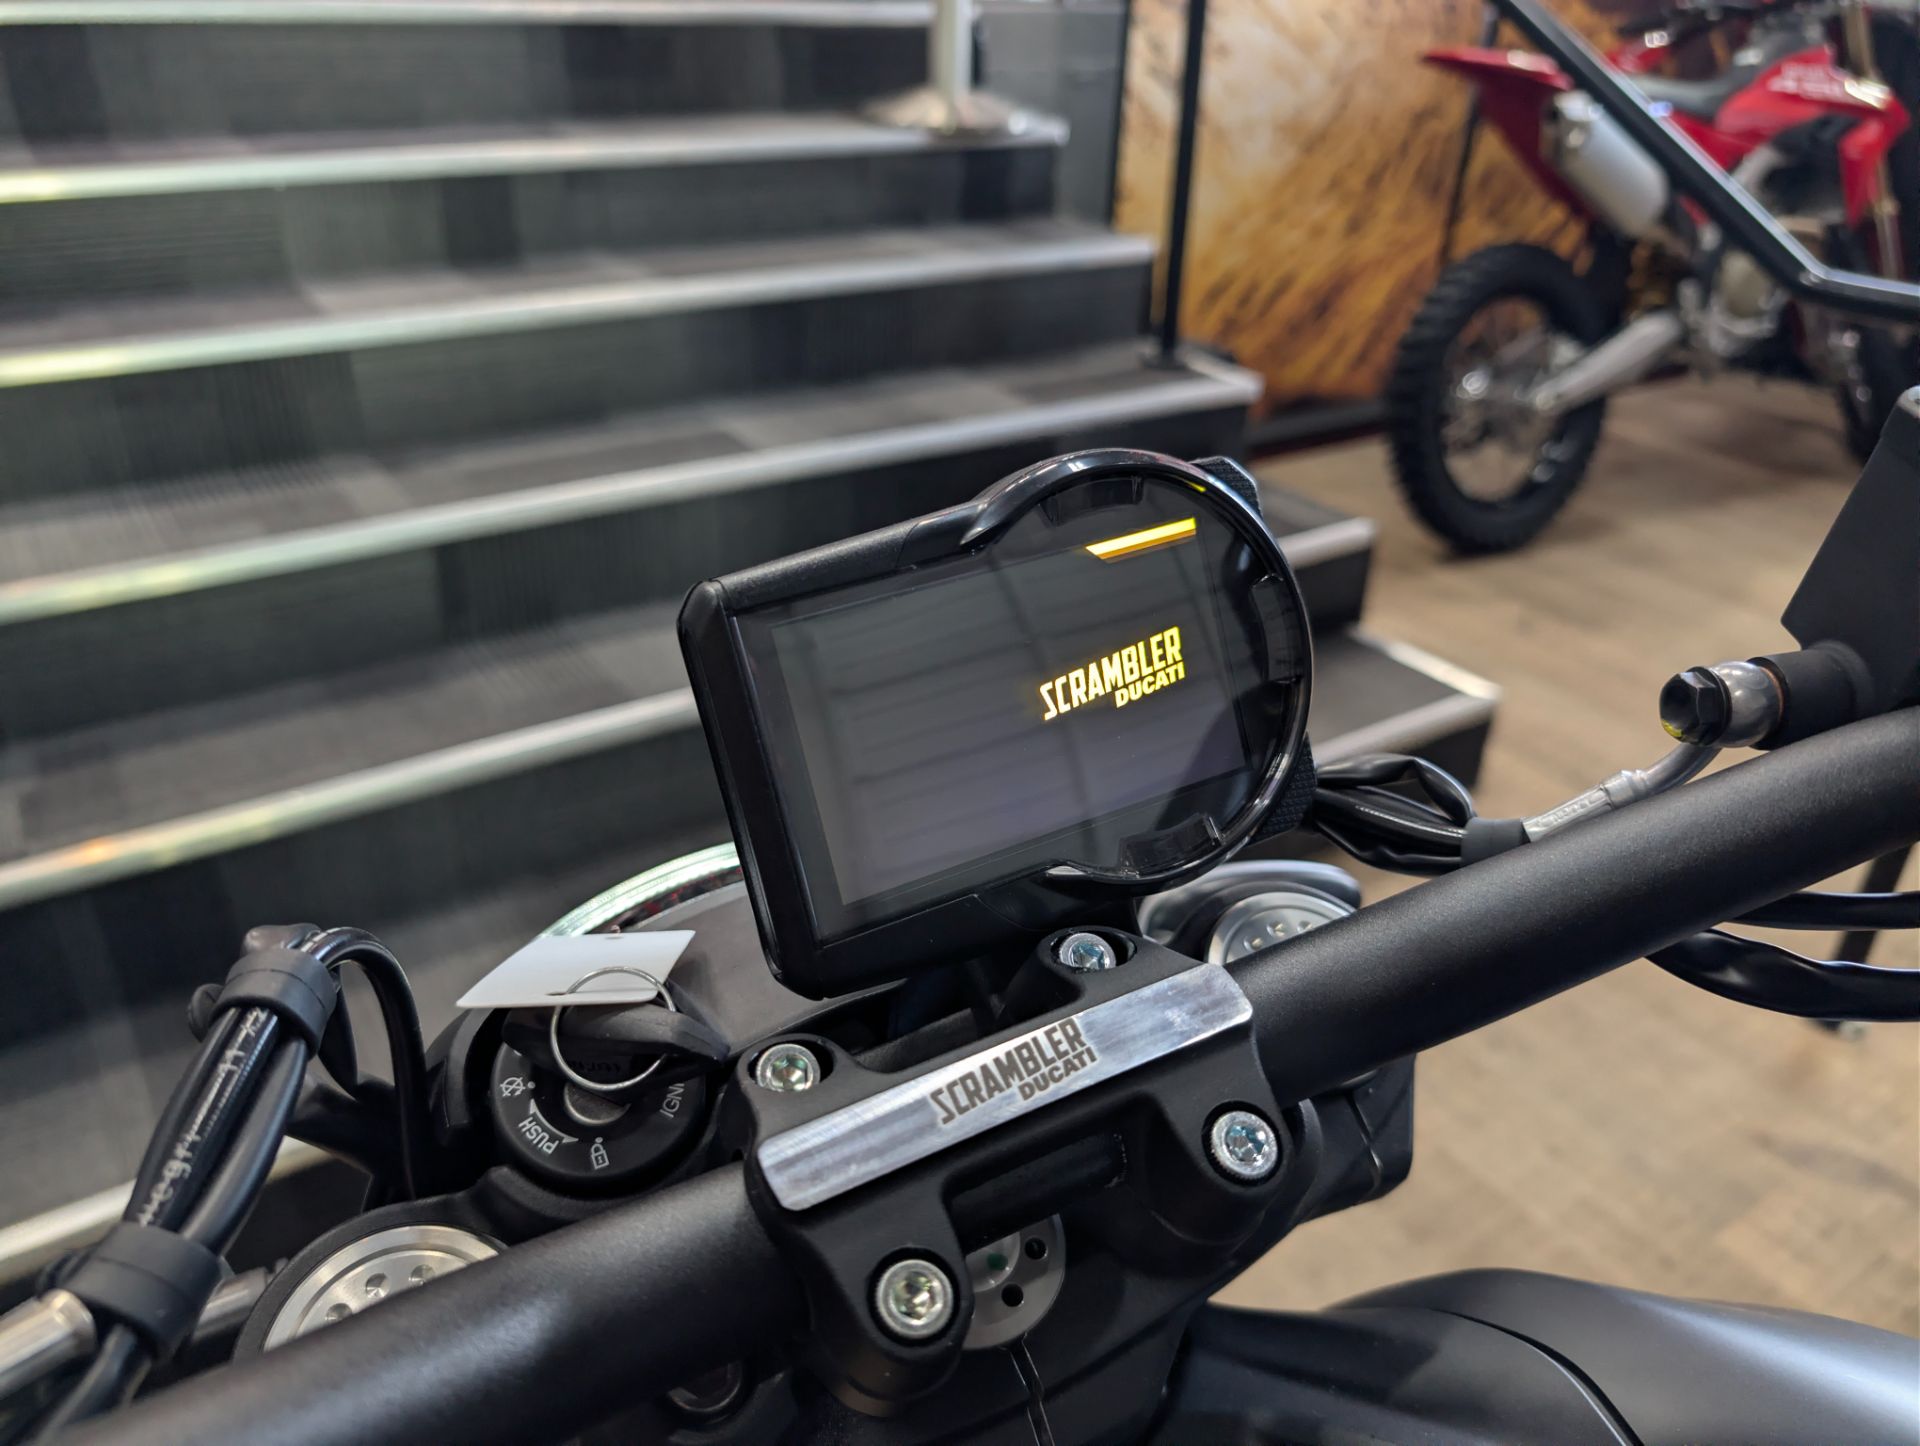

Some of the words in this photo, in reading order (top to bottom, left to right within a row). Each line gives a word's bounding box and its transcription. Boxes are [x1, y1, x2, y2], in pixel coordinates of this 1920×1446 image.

[1039, 625, 1184, 721] SCRAMBLER
[1113, 661, 1186, 709] DUCATI
[929, 1016, 1088, 1126] SCRAMBLER
[1017, 1046, 1098, 1101] DUCATI
[518, 1116, 559, 1154] PUSH
